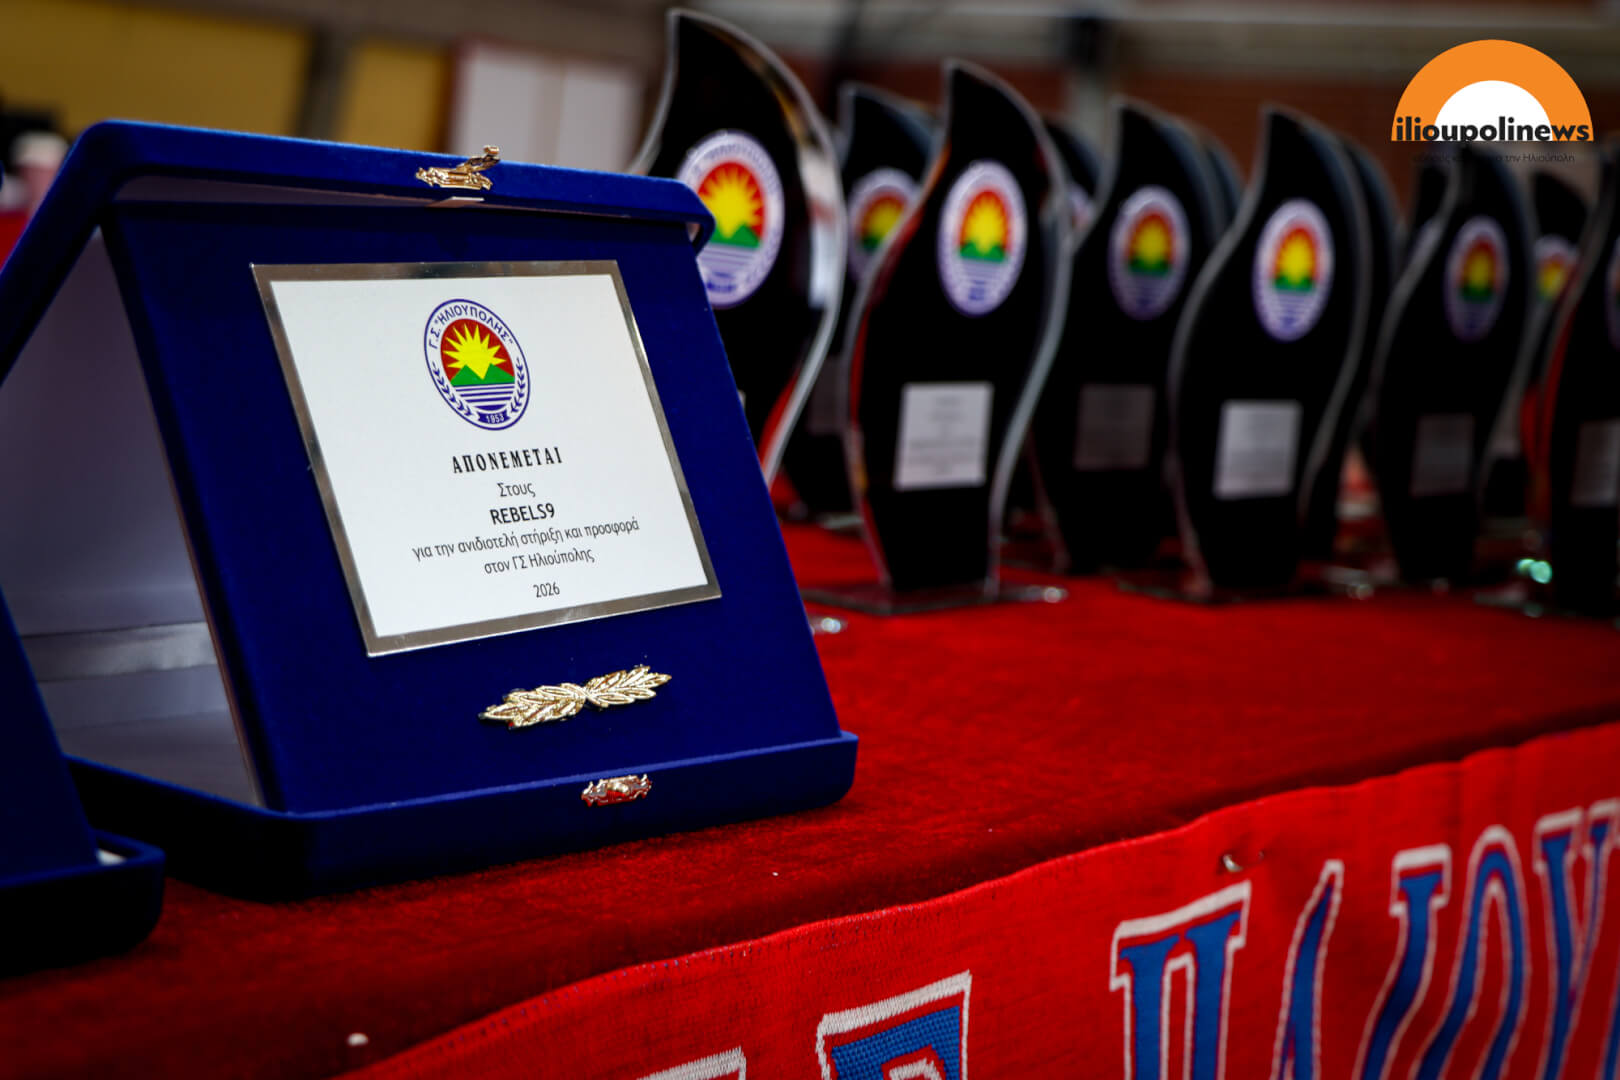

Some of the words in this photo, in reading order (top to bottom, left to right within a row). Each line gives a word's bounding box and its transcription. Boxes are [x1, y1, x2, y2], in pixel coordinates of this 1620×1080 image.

[485, 413, 505, 424] 1953
[452, 446, 562, 474] ΑΠΟΝΕΜΕΤΑΙ
[497, 481, 536, 498] Στους
[489, 502, 556, 525] REBELS9
[412, 545, 433, 562] για
[434, 542, 455, 557] την
[457, 531, 519, 554] ανιδιοτελή
[520, 528, 564, 547] στήριξη
[565, 526, 583, 540] και
[584, 515, 640, 539] προσφορά
[484, 559, 510, 575] στον
[512, 554, 528, 570] ΓΣ
[528, 547, 595, 568] Ηλιούπολης
[533, 581, 560, 599] 2026
